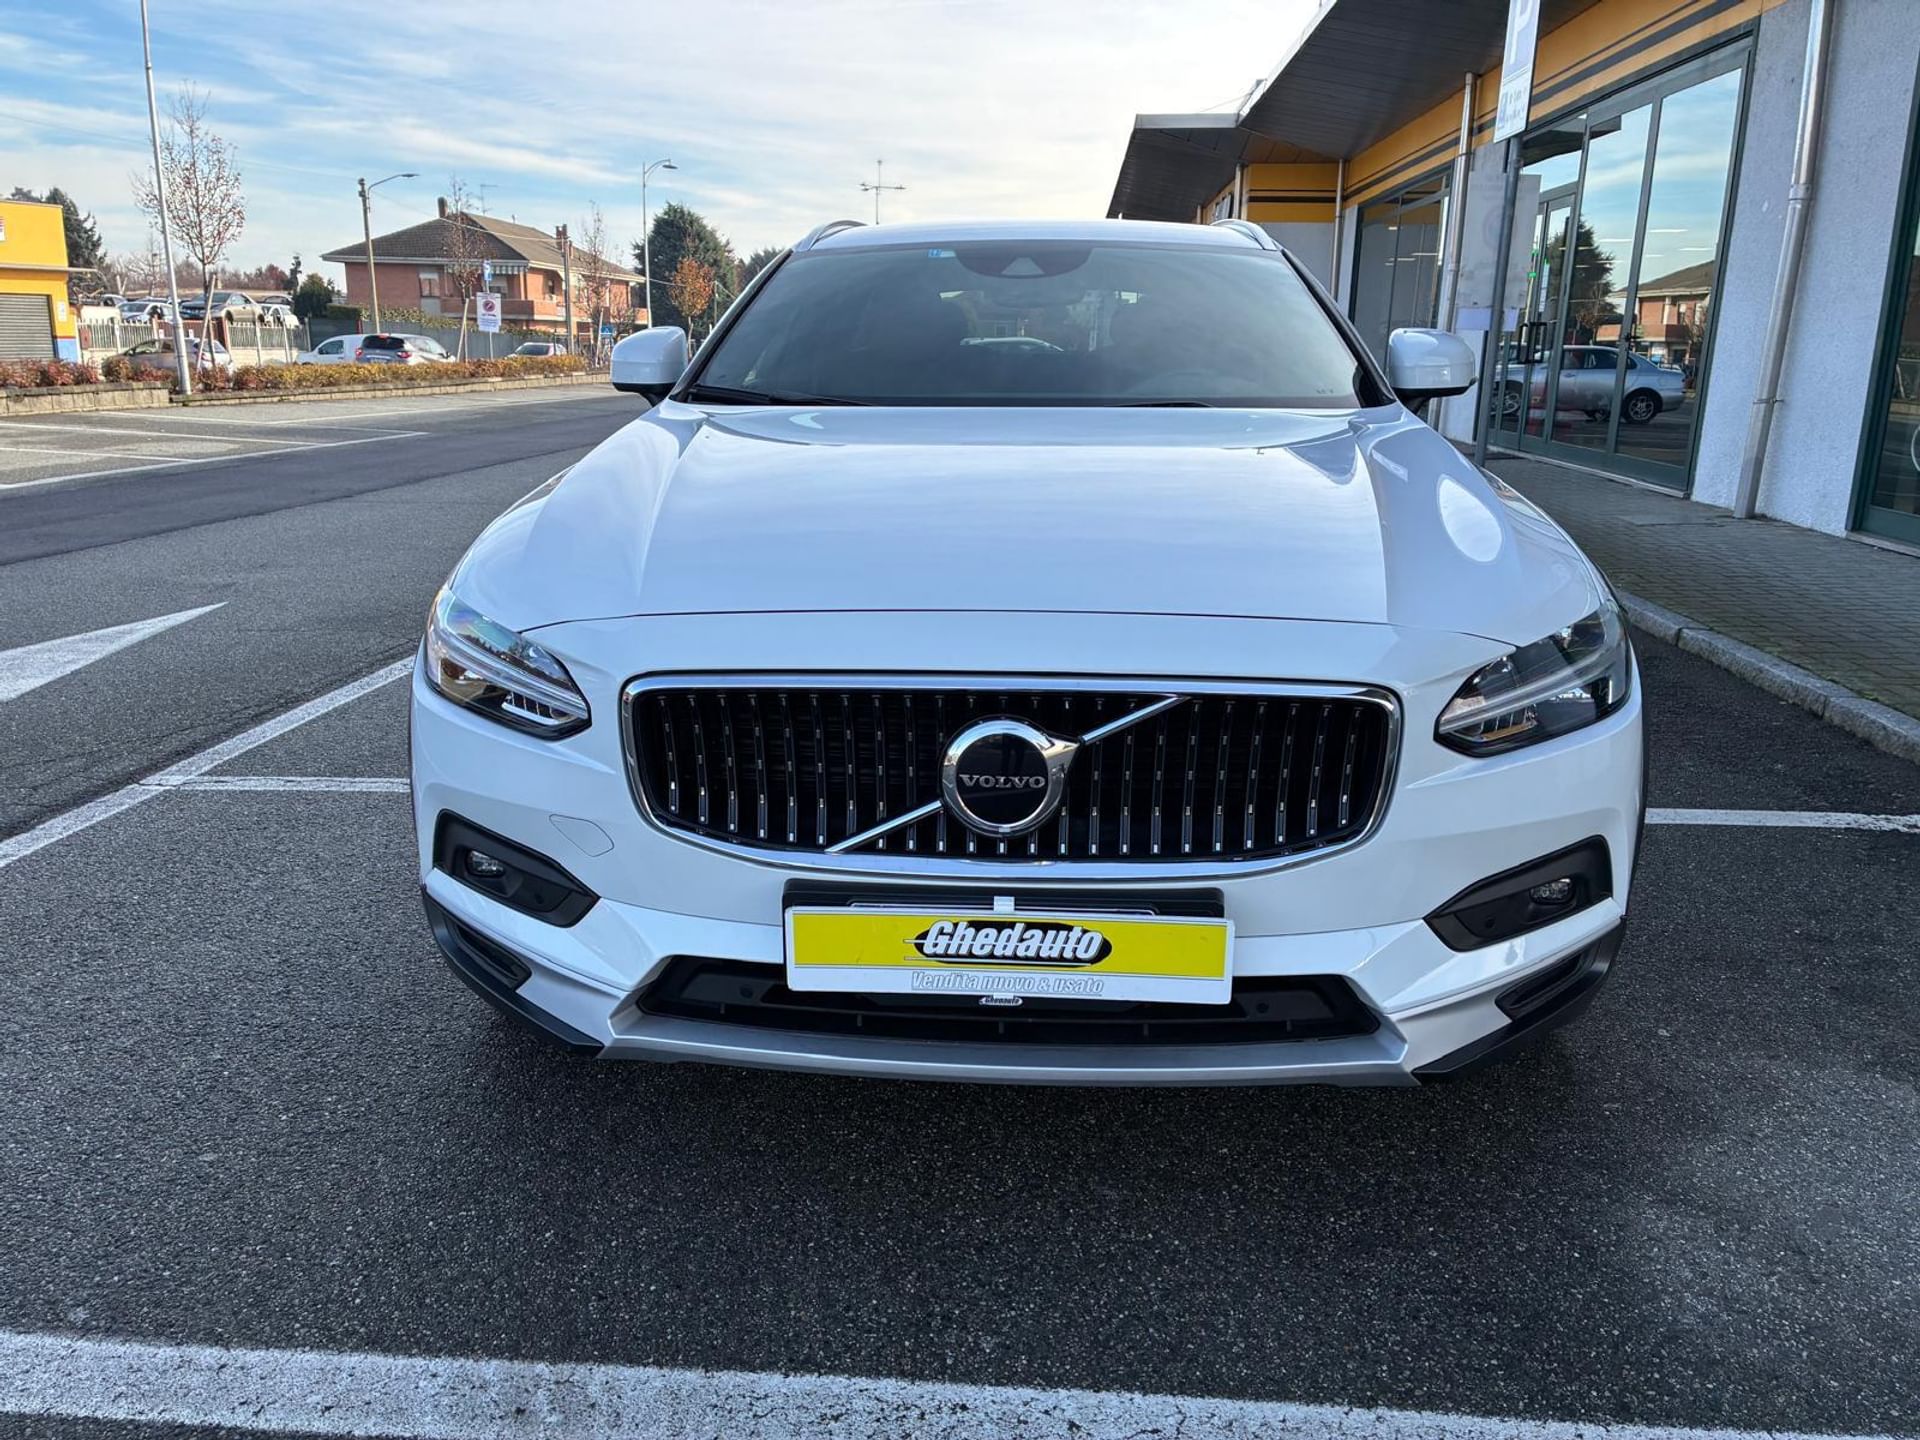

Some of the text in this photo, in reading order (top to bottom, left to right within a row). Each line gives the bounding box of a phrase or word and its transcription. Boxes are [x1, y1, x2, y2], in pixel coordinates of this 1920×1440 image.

[959, 773, 1046, 789] VOLVO
[922, 920, 1104, 961] Ghedauto
[911, 971, 1104, 993] Vendita nuovo & usato
